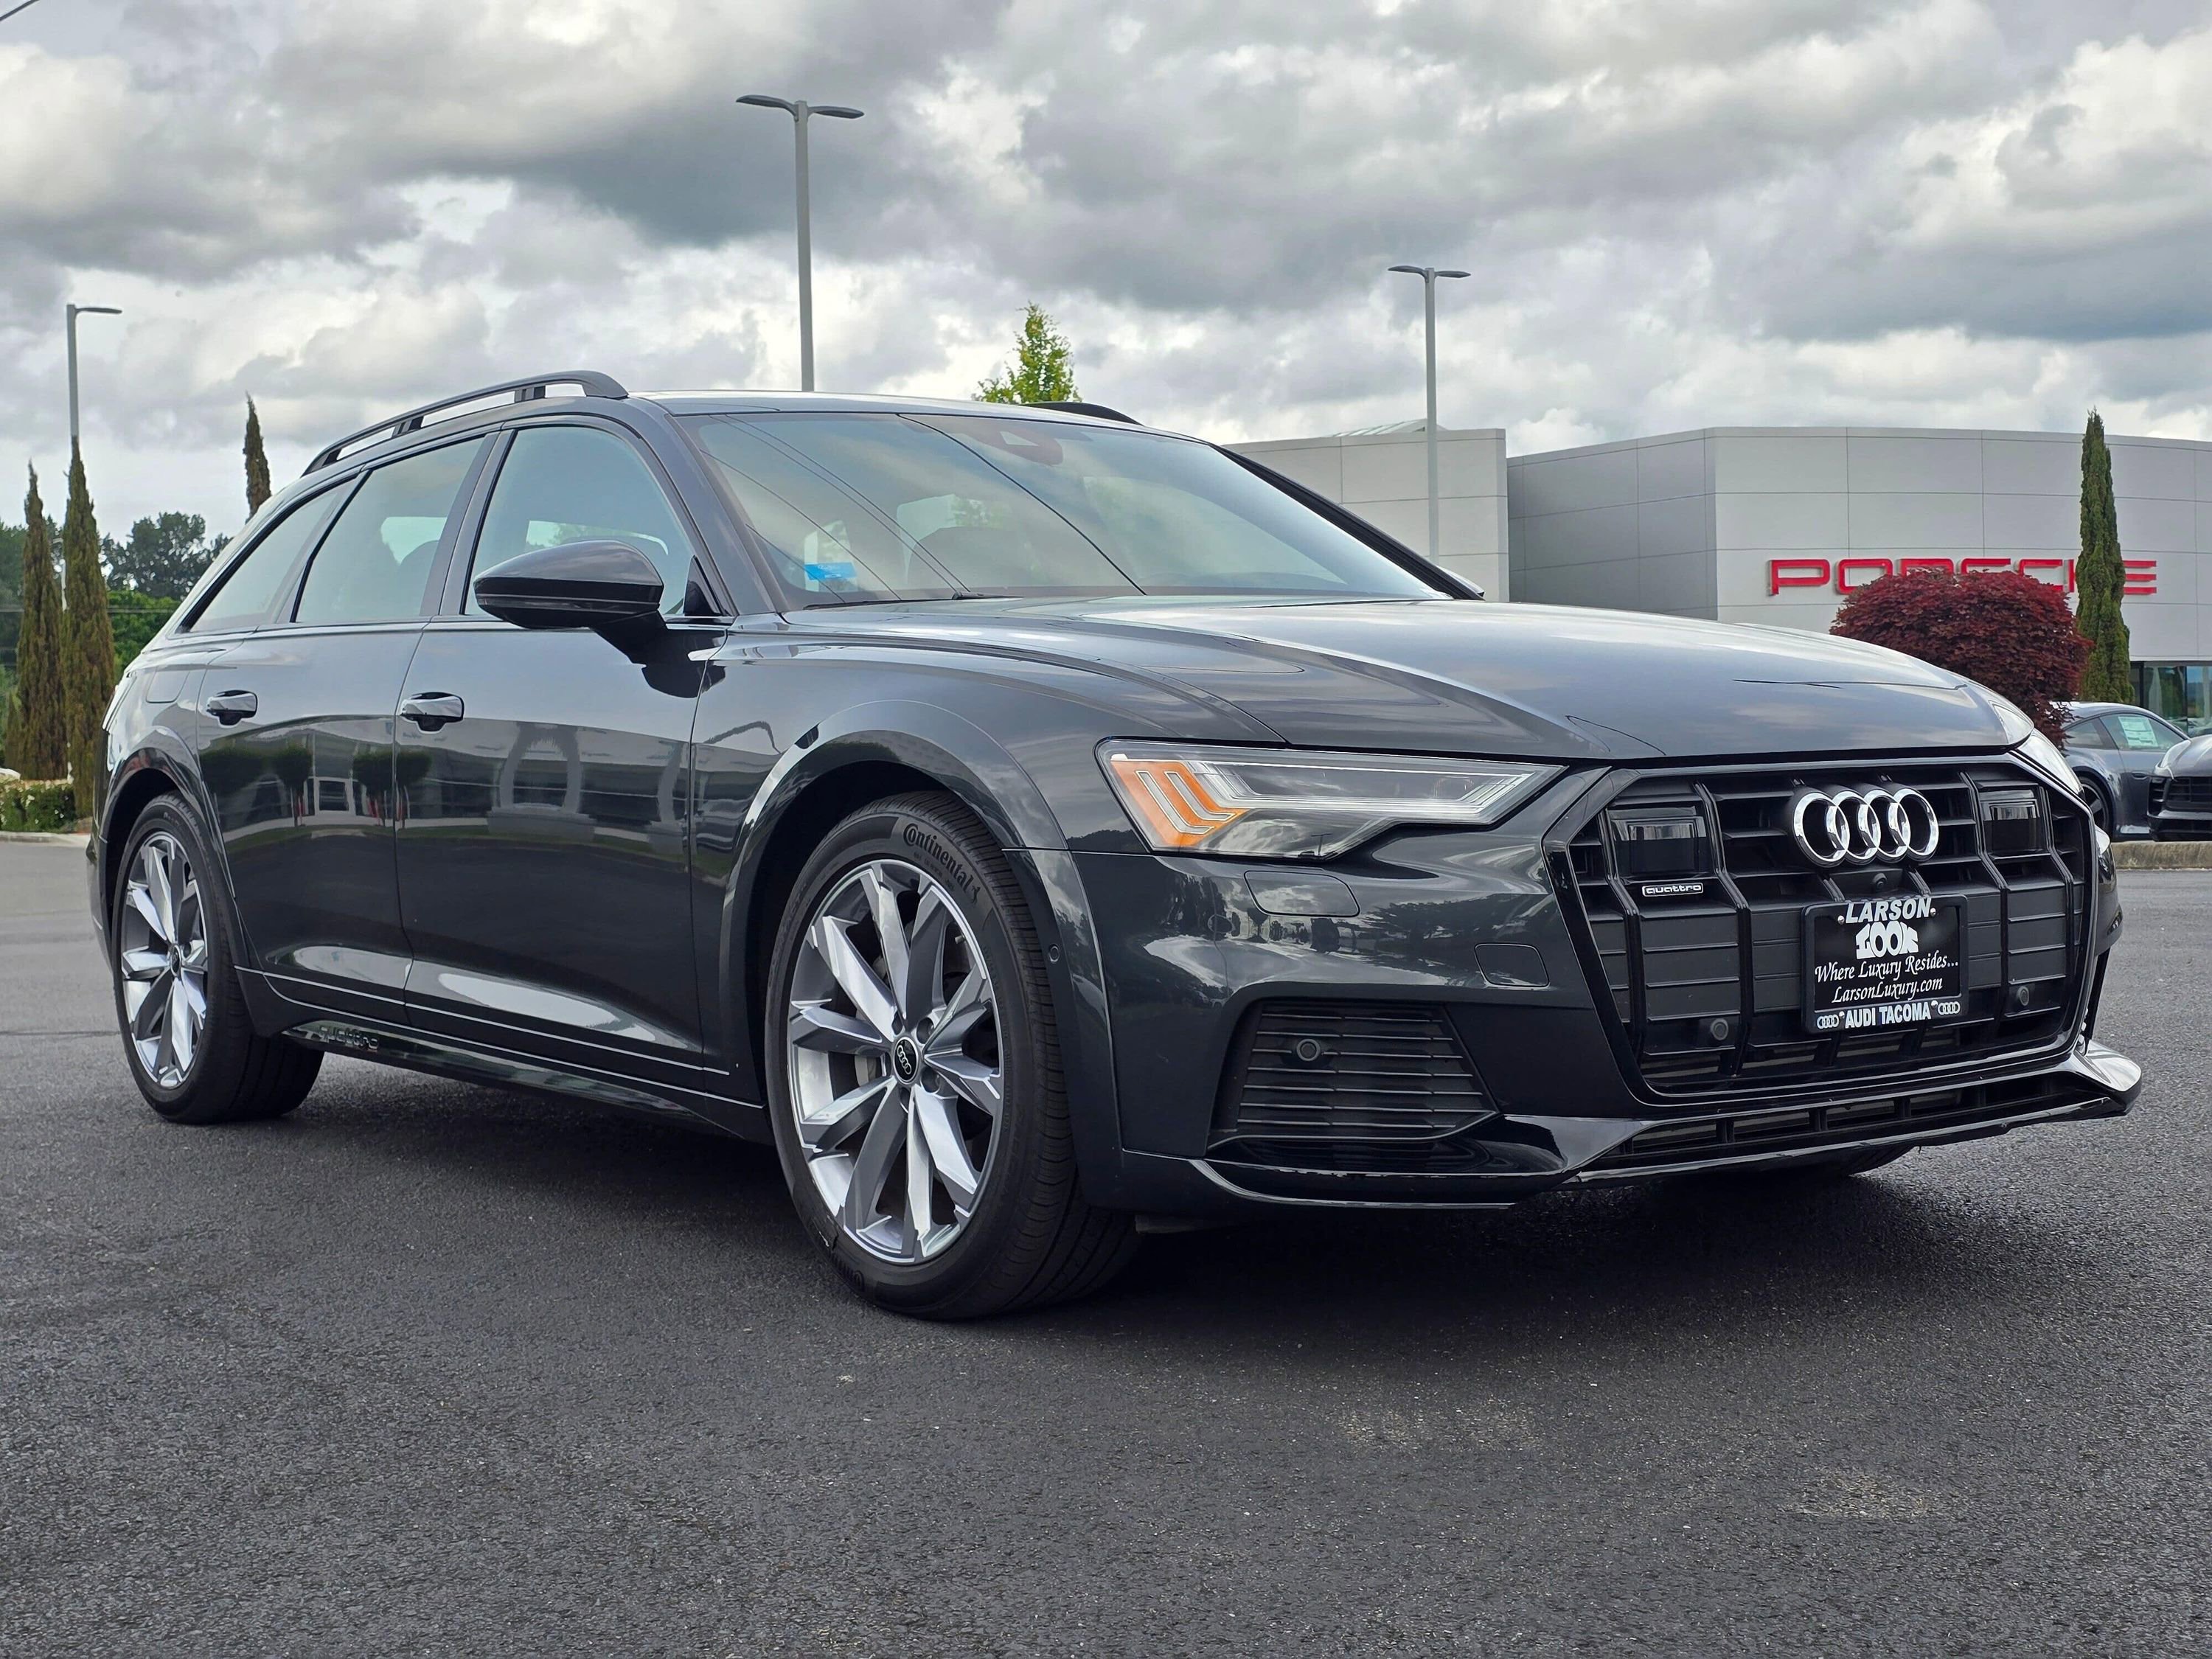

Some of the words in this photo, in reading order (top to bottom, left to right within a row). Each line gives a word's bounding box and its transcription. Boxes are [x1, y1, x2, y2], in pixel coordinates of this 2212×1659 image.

[903, 823, 975, 891] Continental
[1646, 885, 1701, 894] quattro
[1846, 897, 1932, 923] LARSON
[1855, 920, 1919, 959] LOOK
[1815, 961, 1855, 983] Where
[1857, 961, 1902, 980] Luxury
[1905, 950, 1958, 975] Resides...
[1831, 977, 1943, 1004] LarsonLuxury.com
[1845, 1008, 1876, 1029] AUDI
[1879, 1001, 1931, 1025] TACOMA
